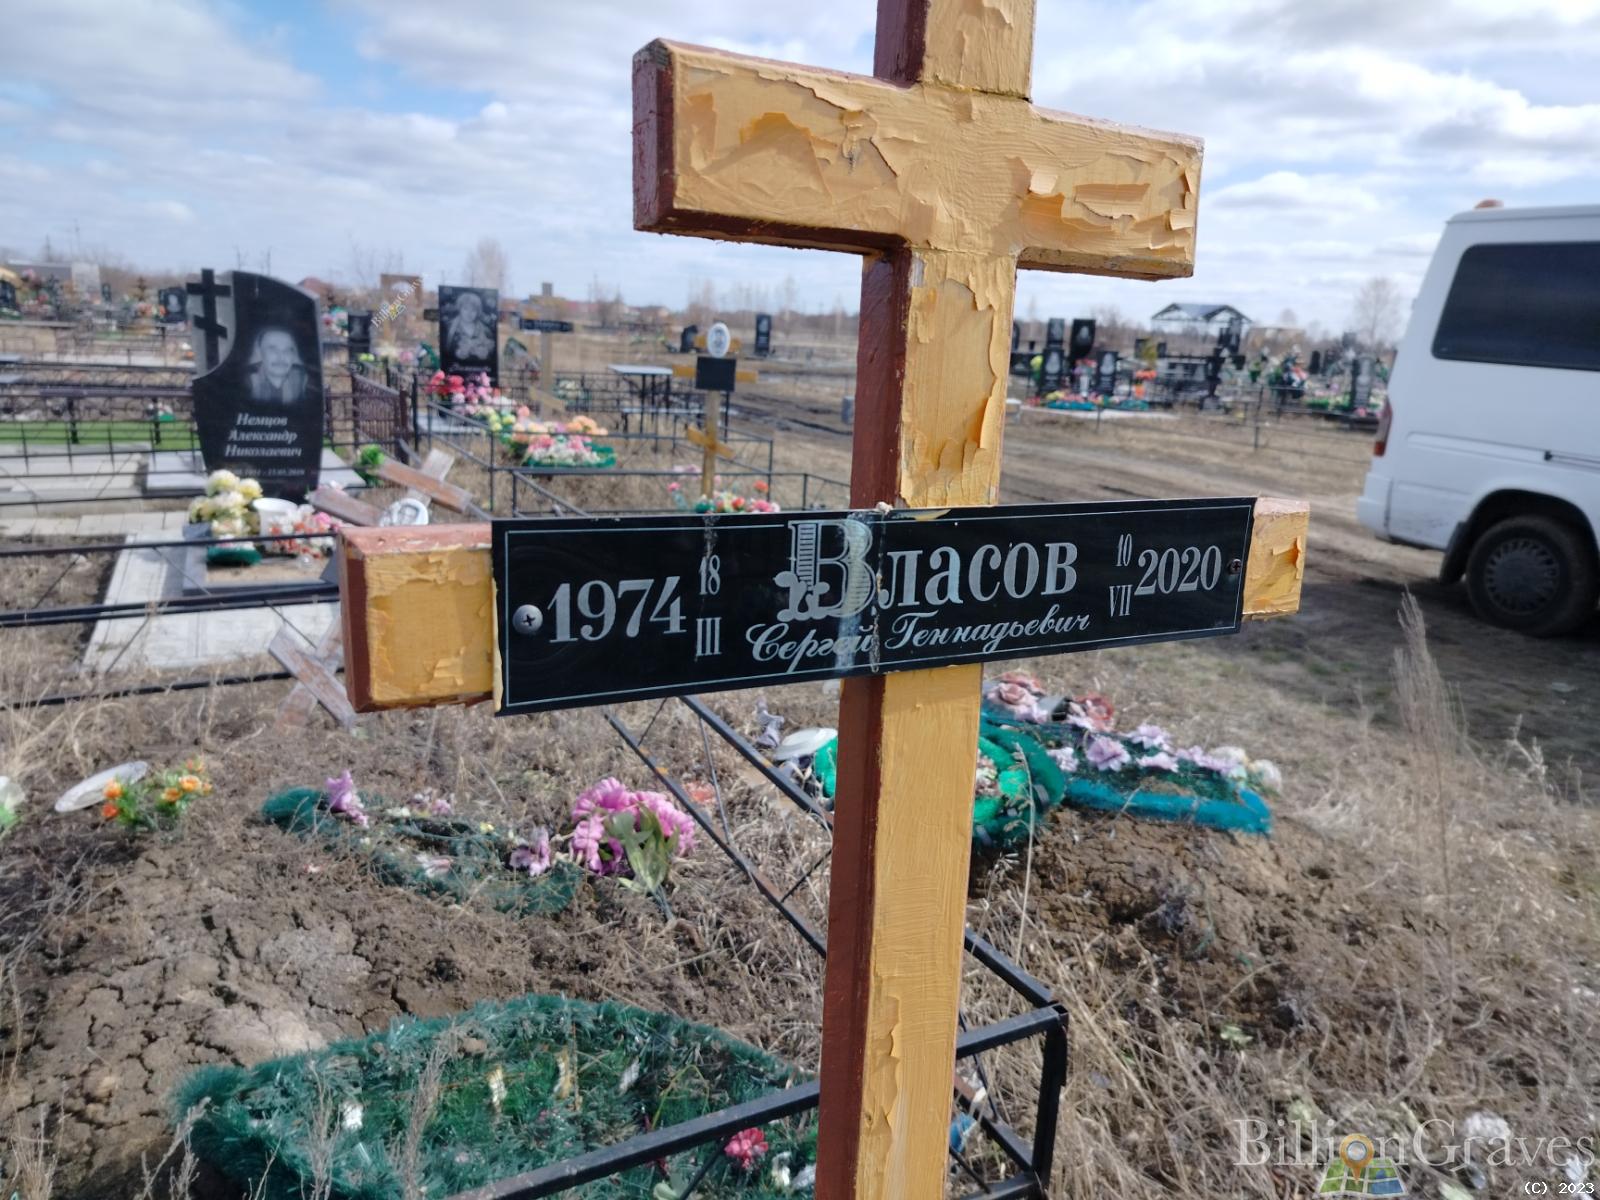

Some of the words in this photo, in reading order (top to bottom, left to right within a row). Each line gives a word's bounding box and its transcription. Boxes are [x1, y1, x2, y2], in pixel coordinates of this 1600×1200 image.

[228, 430, 298, 444] Александр
[236, 413, 288, 427] Немцов
[224, 445, 302, 457] Николаевич
[1115, 533, 1133, 567] 10
[699, 554, 721, 596] 18
[773, 519, 1078, 622] Власов
[1134, 545, 1222, 596] 2020
[547, 575, 687, 643] 1974
[1109, 584, 1133, 618] VII
[695, 617, 722, 657] III
[745, 623, 876, 674] Сергей
[884, 603, 1090, 654] Геннадьевич
